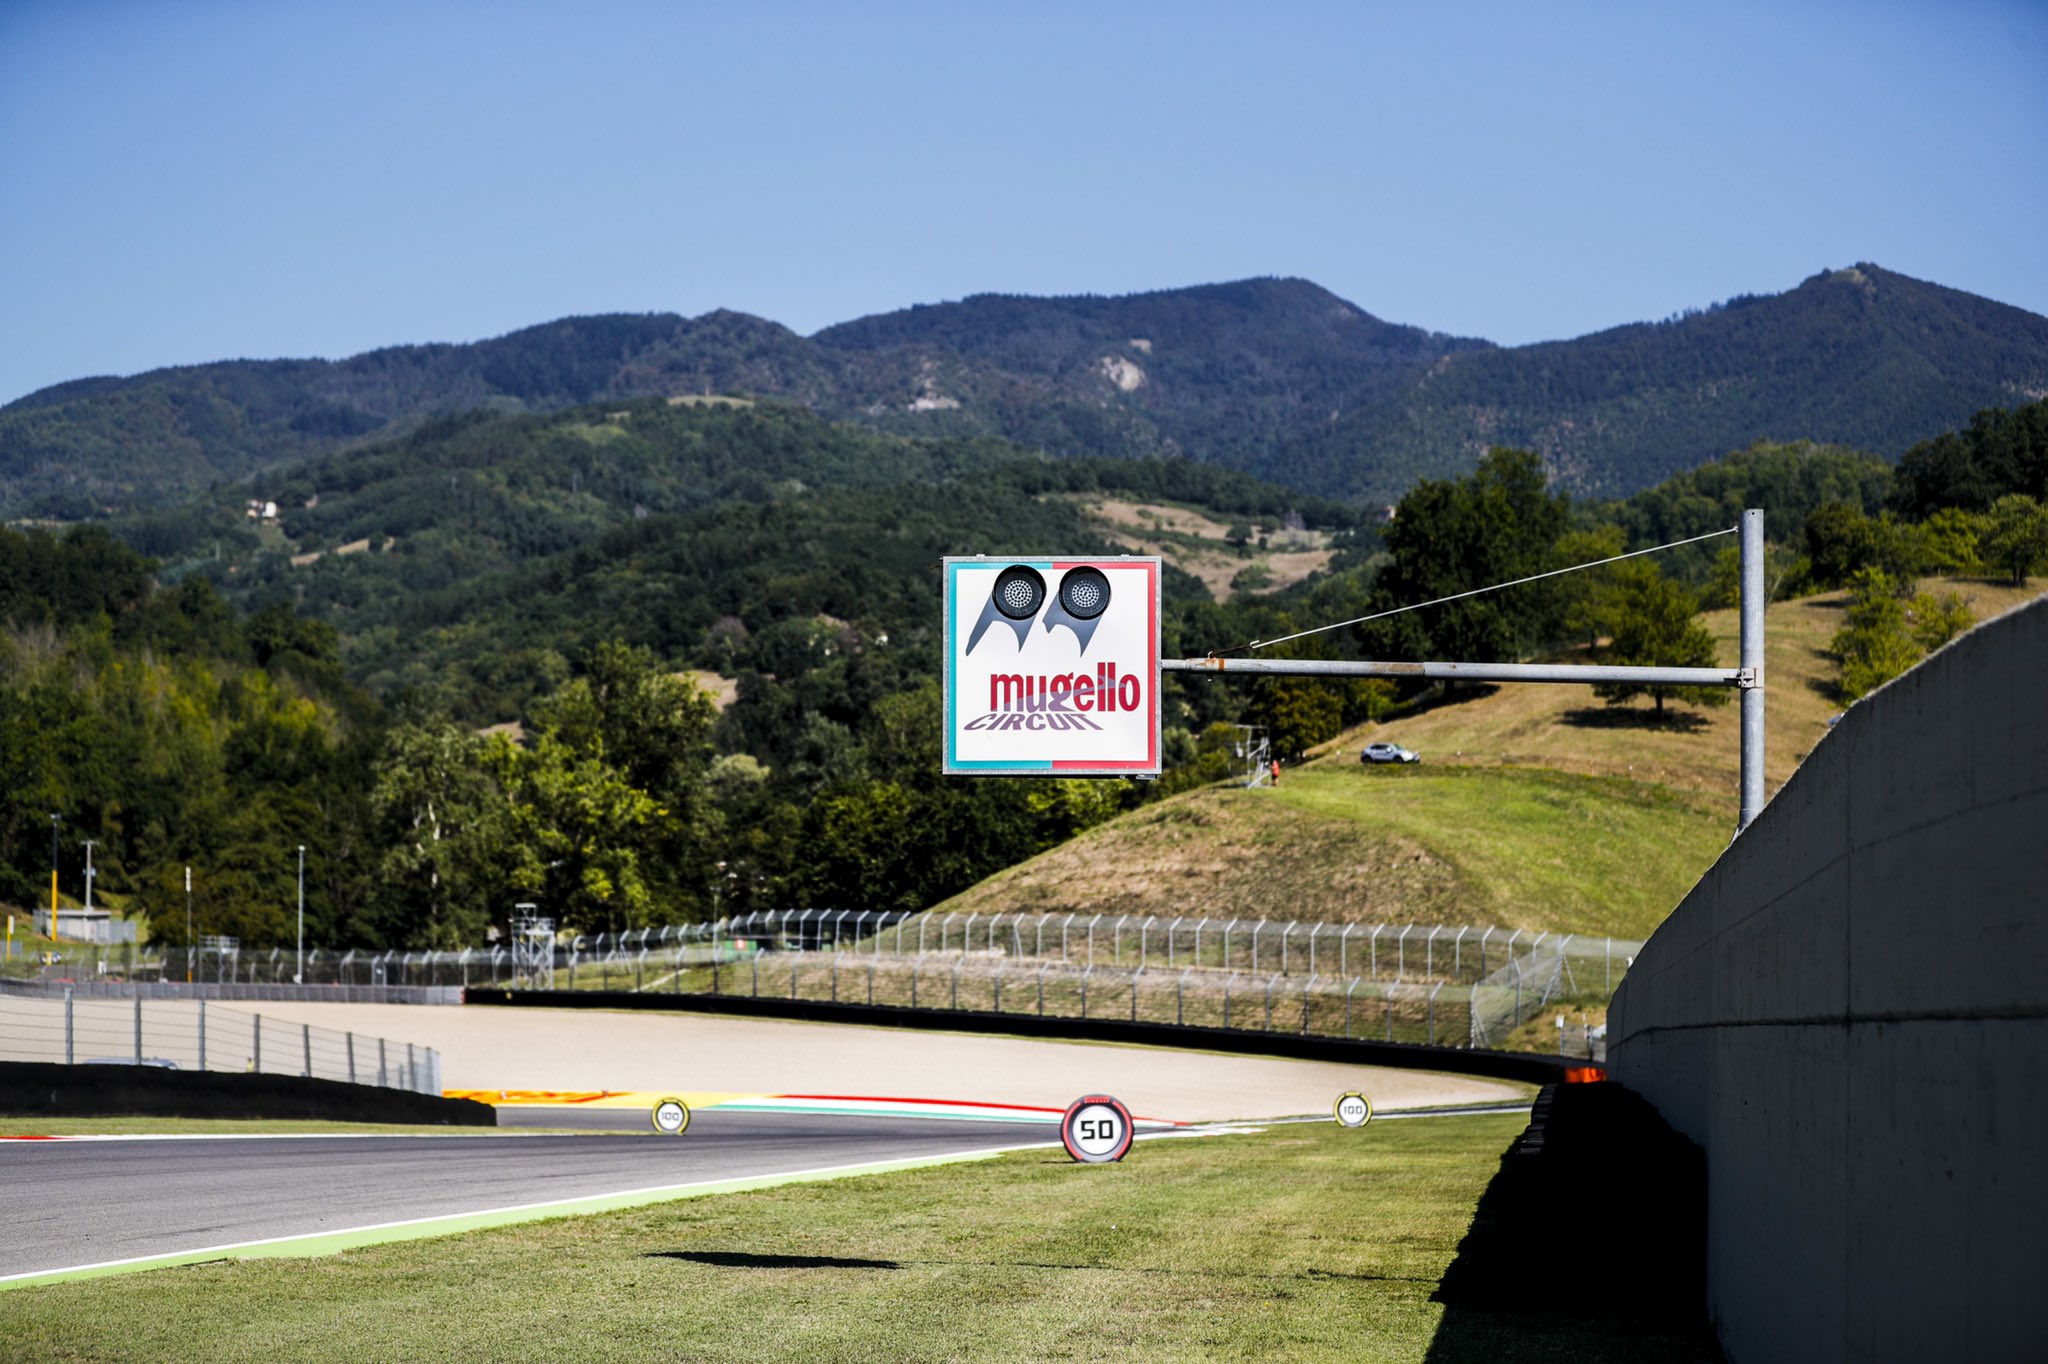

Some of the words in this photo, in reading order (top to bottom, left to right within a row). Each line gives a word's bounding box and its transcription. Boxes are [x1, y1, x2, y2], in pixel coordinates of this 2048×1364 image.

[990, 662, 1141, 713] mugello
[963, 713, 1104, 730] CIRCUIT
[661, 1112, 680, 1121] 100
[1343, 1105, 1363, 1115] 100
[1080, 1120, 1114, 1140] 50
